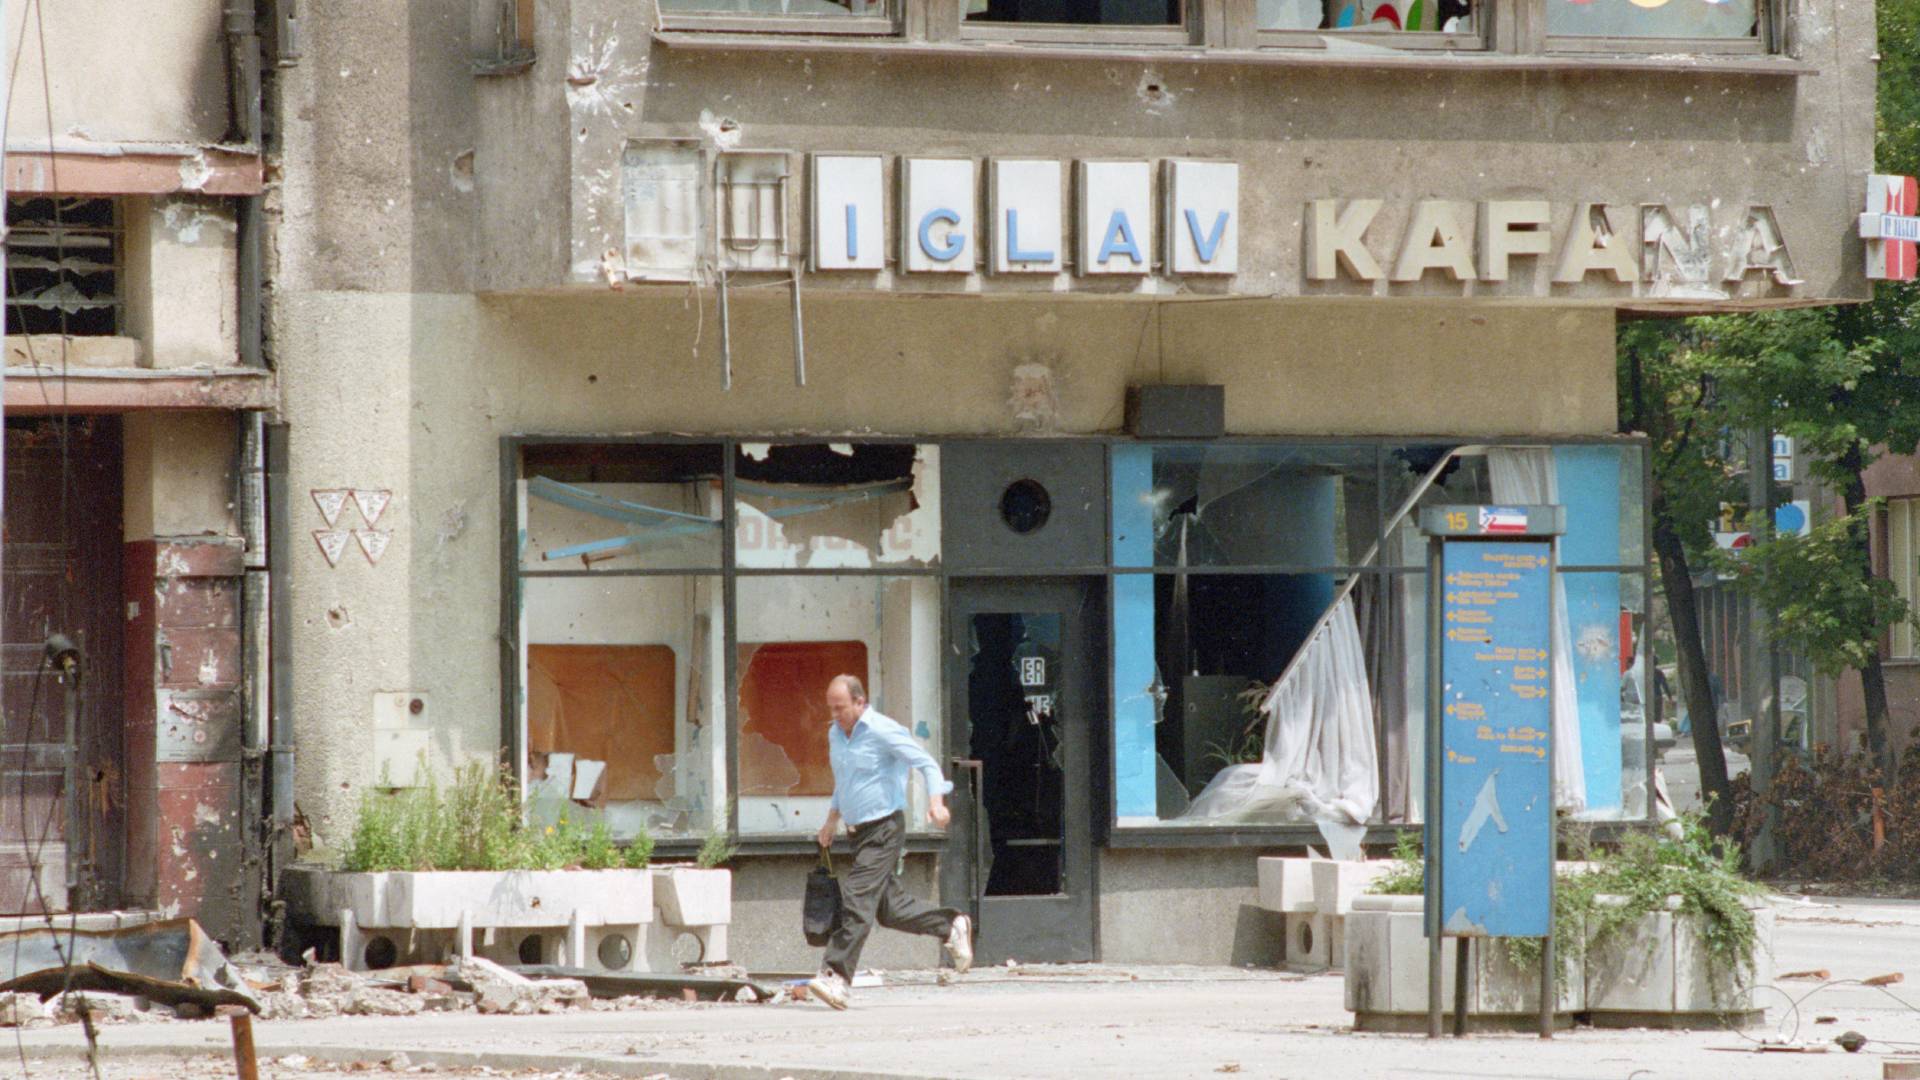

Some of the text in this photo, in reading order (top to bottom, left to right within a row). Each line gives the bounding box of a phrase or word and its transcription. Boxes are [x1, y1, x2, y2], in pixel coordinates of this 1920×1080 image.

[845, 203, 1230, 265] IGLAV
[1306, 199, 1804, 285] KAFANA
[1446, 511, 1468, 530] 15
